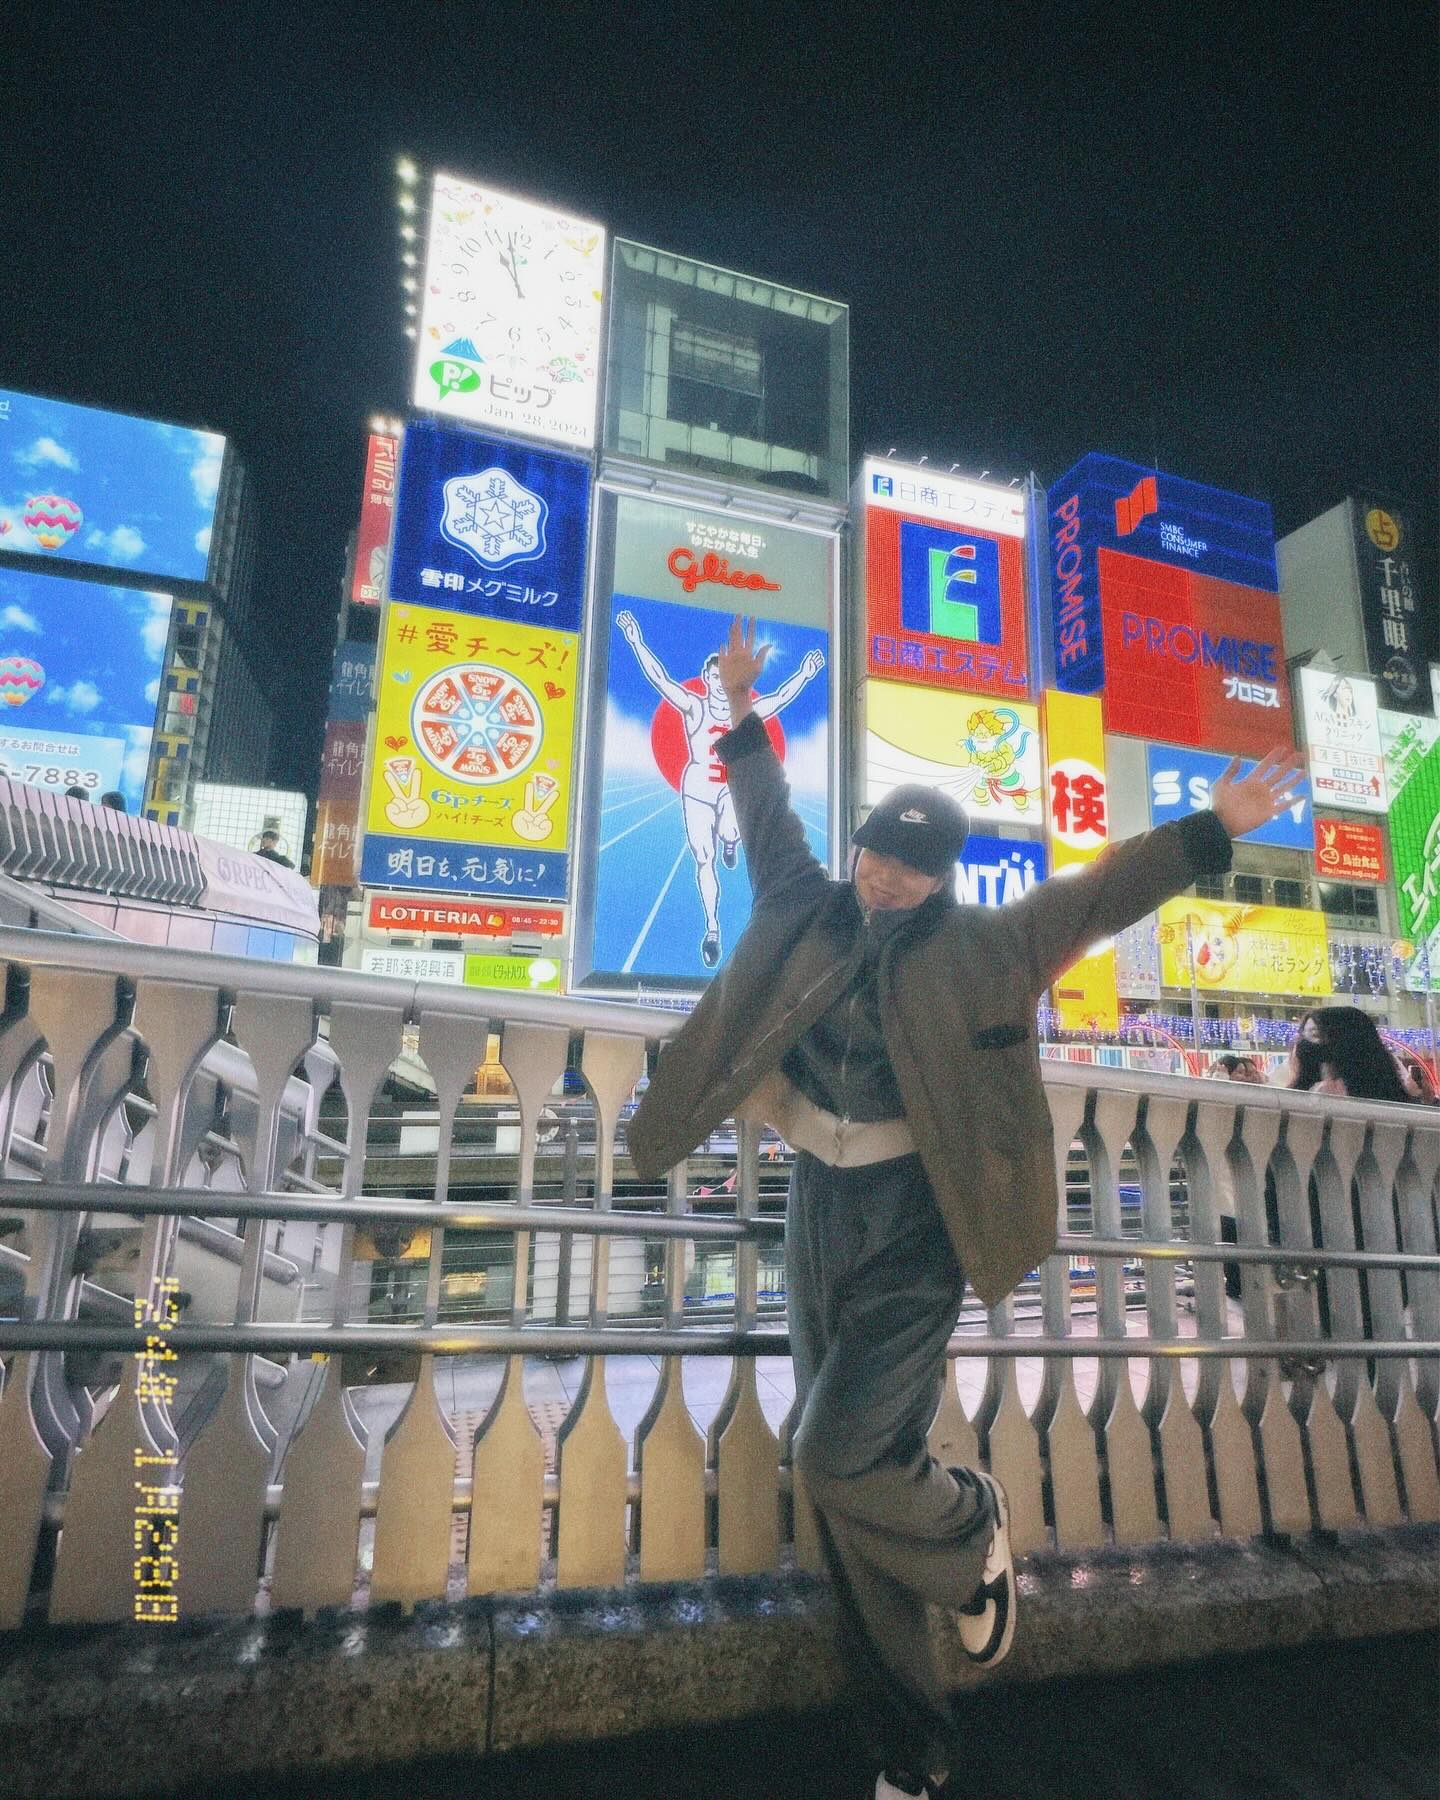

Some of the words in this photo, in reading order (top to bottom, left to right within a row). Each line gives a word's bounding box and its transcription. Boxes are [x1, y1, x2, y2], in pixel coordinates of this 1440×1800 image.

[489, 374, 557, 409] ピップ
[483, 403, 514, 421] Jan
[548, 418, 588, 439] 2024
[1160, 521, 1185, 535] SMBC
[1160, 532, 1208, 552] CONSUMER
[667, 546, 782, 592] Glico
[1161, 541, 1200, 559] FINANCE
[420, 567, 559, 608] 雪印メグミルク
[1055, 494, 1088, 669] PROMISE
[871, 633, 1028, 685] 日商エステム
[1121, 611, 1278, 682] PROMISE
[1222, 676, 1281, 708] プロミス
[1051, 770, 1107, 839] 検
[387, 848, 546, 888] 明日を、元気に!
[379, 906, 482, 927] LOTTERIA
